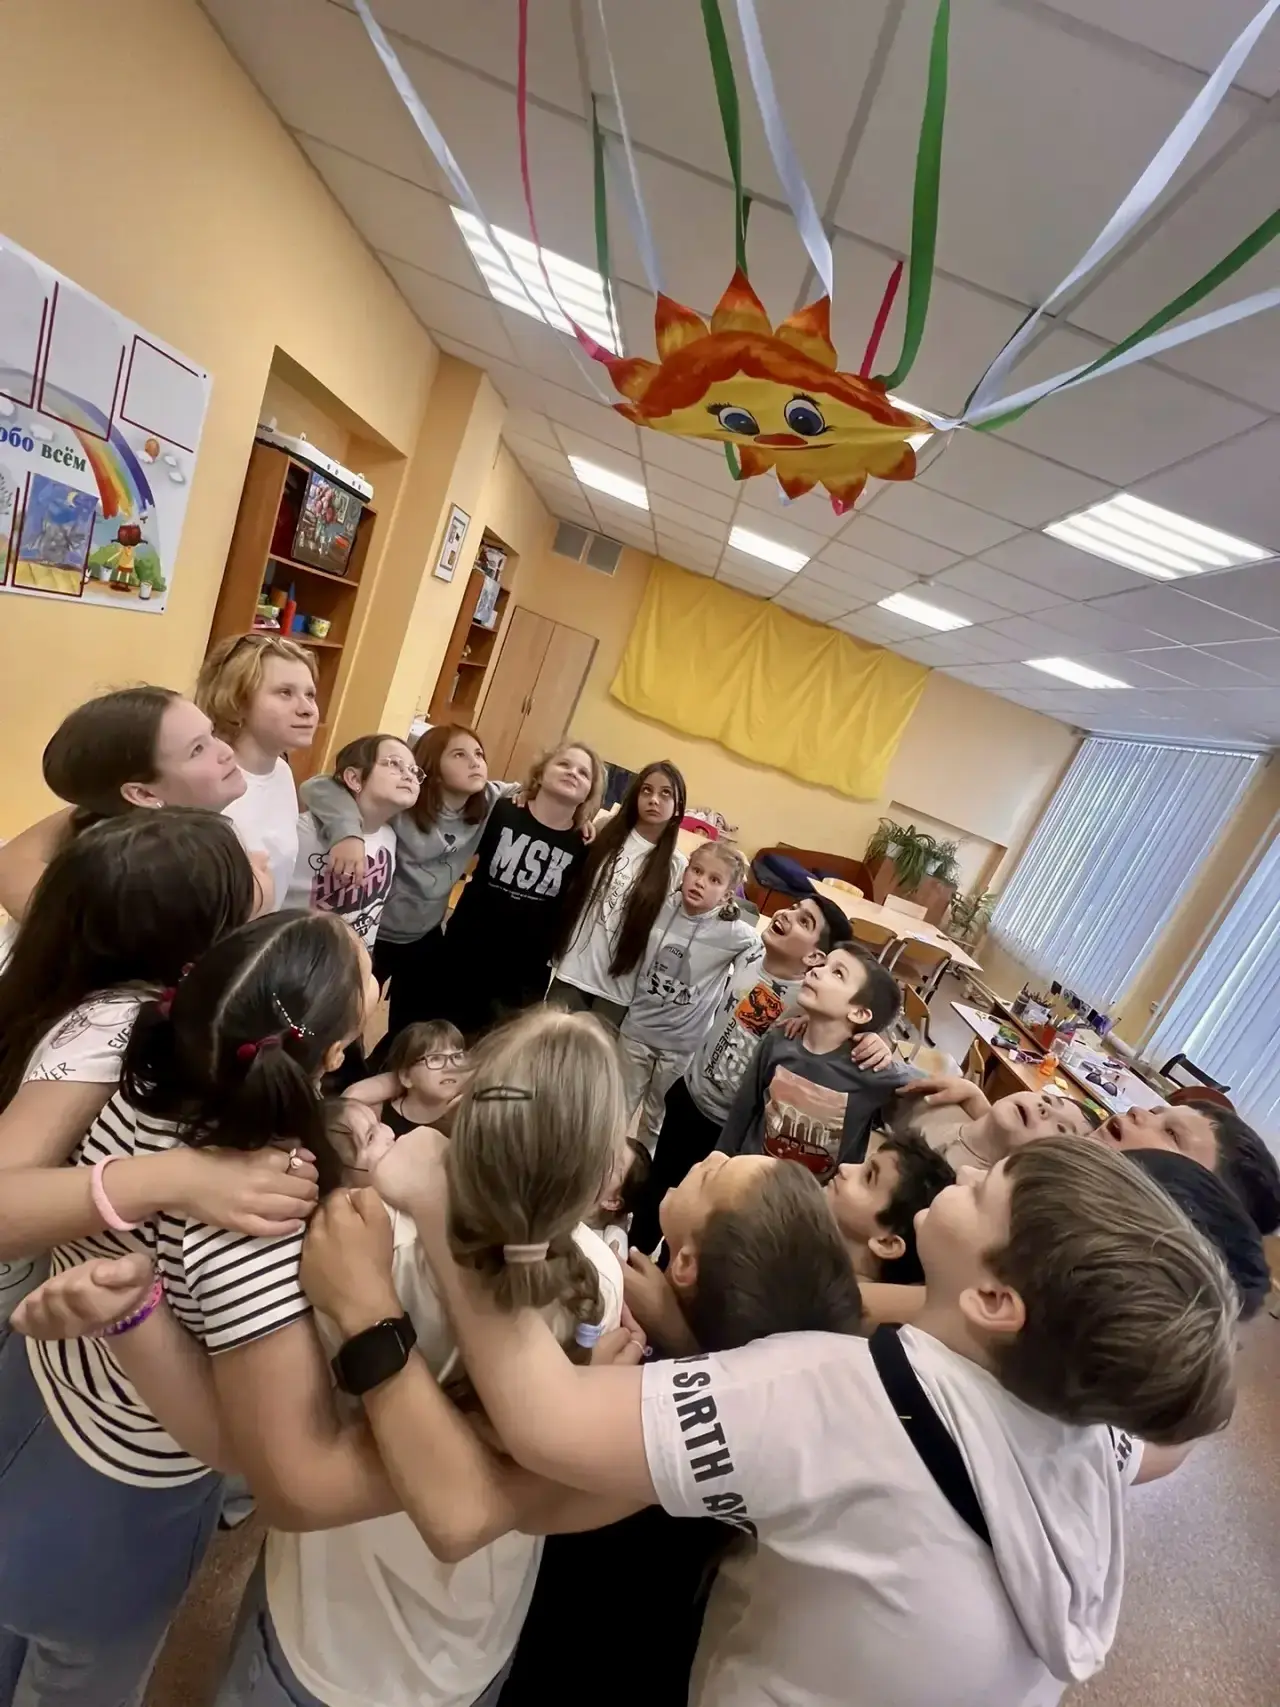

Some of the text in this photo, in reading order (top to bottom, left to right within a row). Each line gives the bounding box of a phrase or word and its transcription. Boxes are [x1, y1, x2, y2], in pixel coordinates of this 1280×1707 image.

[41, 443, 87, 472] всём
[489, 826, 574, 897] MSK
[107, 1021, 136, 1050] EVE
[704, 1017, 737, 1079] AWESOME
